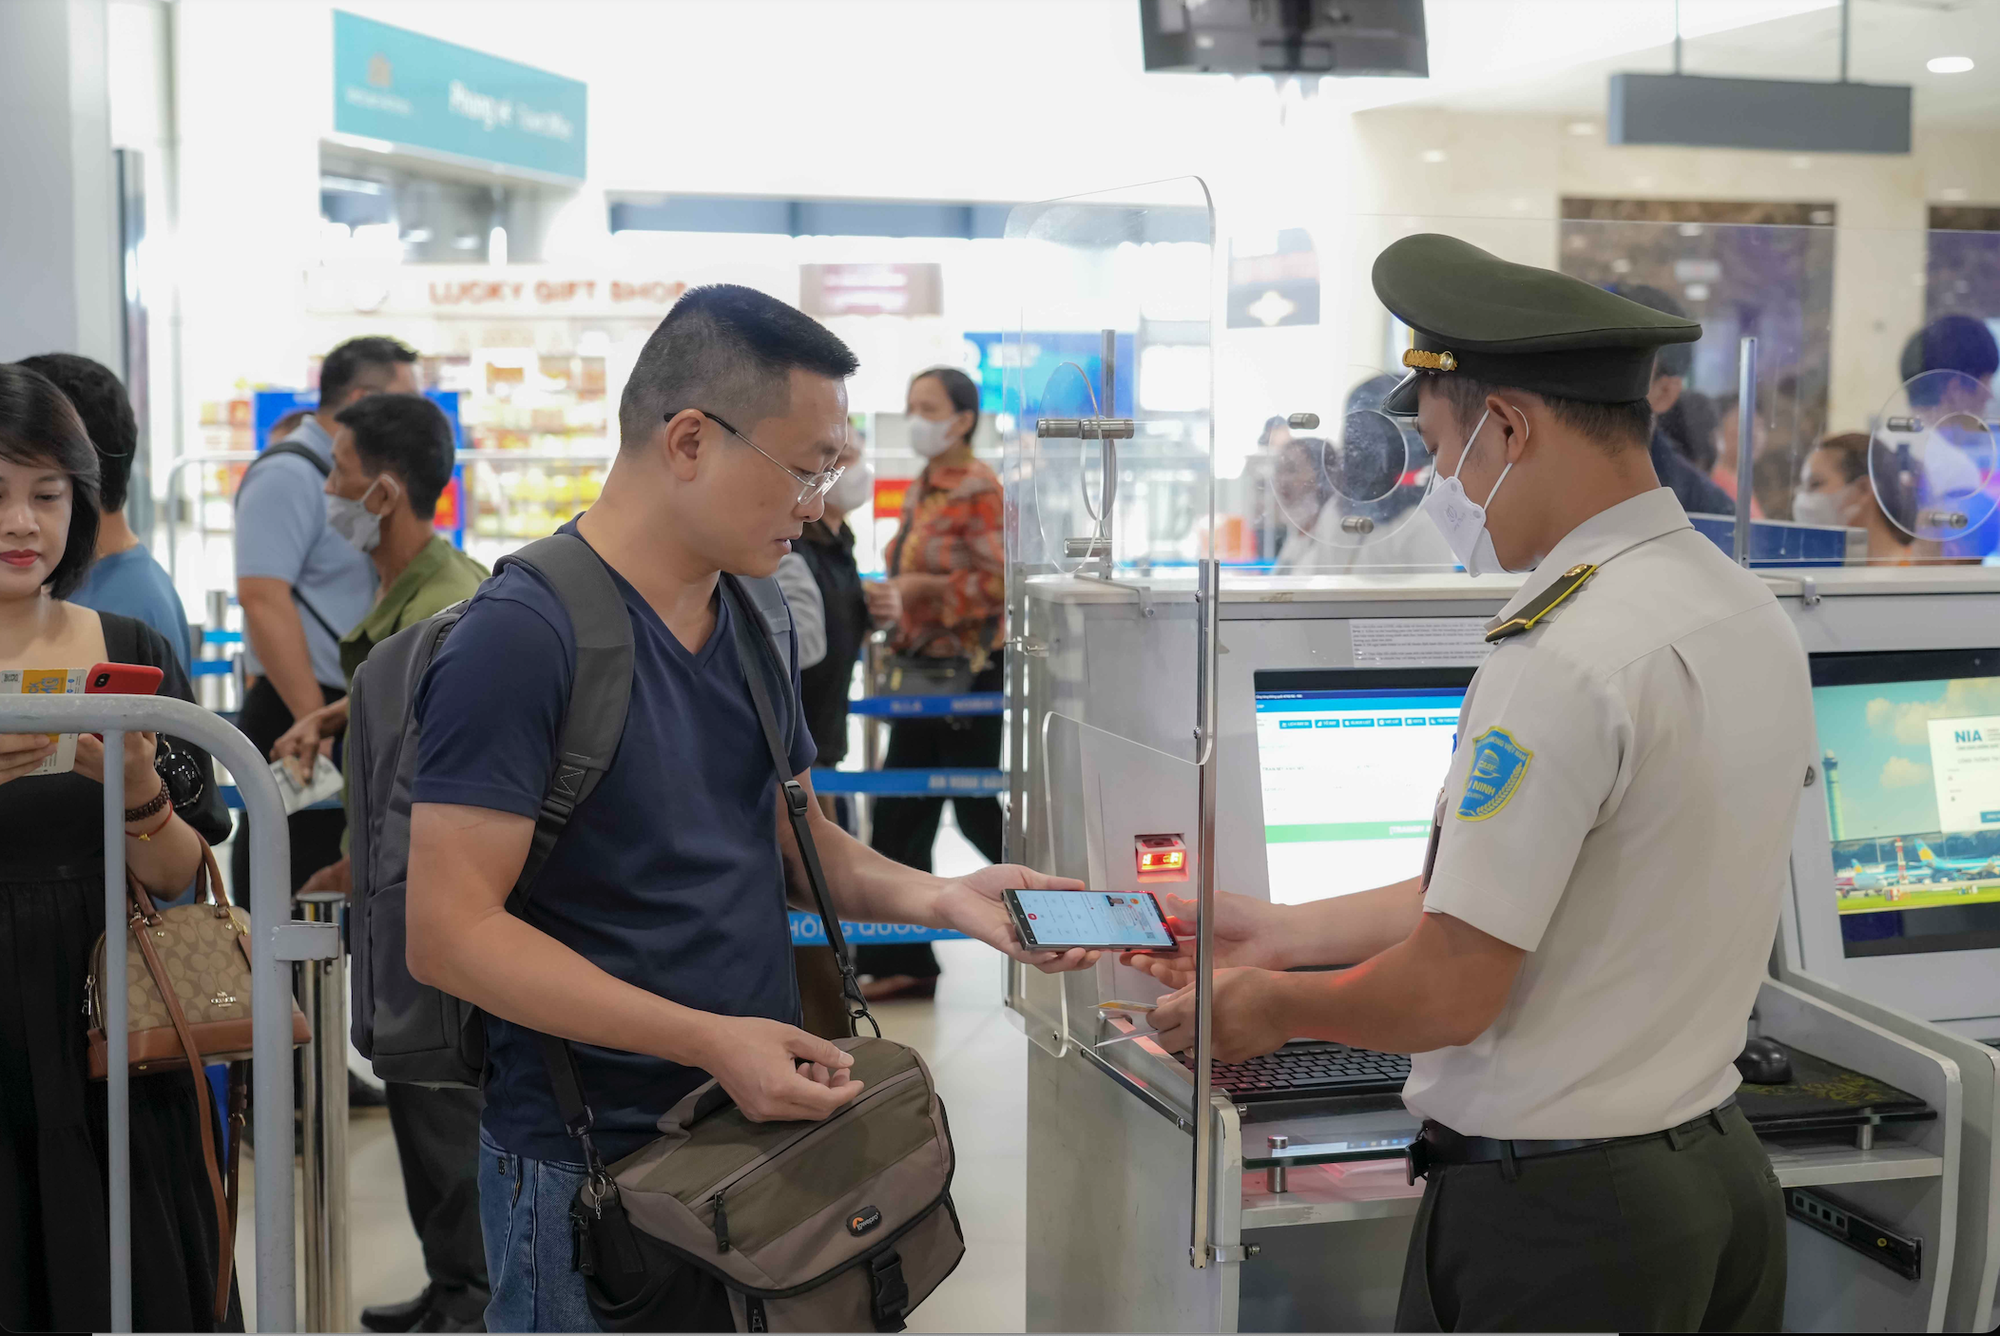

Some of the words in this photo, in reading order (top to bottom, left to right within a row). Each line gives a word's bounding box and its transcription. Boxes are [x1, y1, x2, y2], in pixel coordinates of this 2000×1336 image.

[429, 281, 524, 305] LUCKY
[534, 281, 597, 304] GIFT
[1954, 729, 1983, 743] NIA
[1473, 780, 1496, 796] NINH
